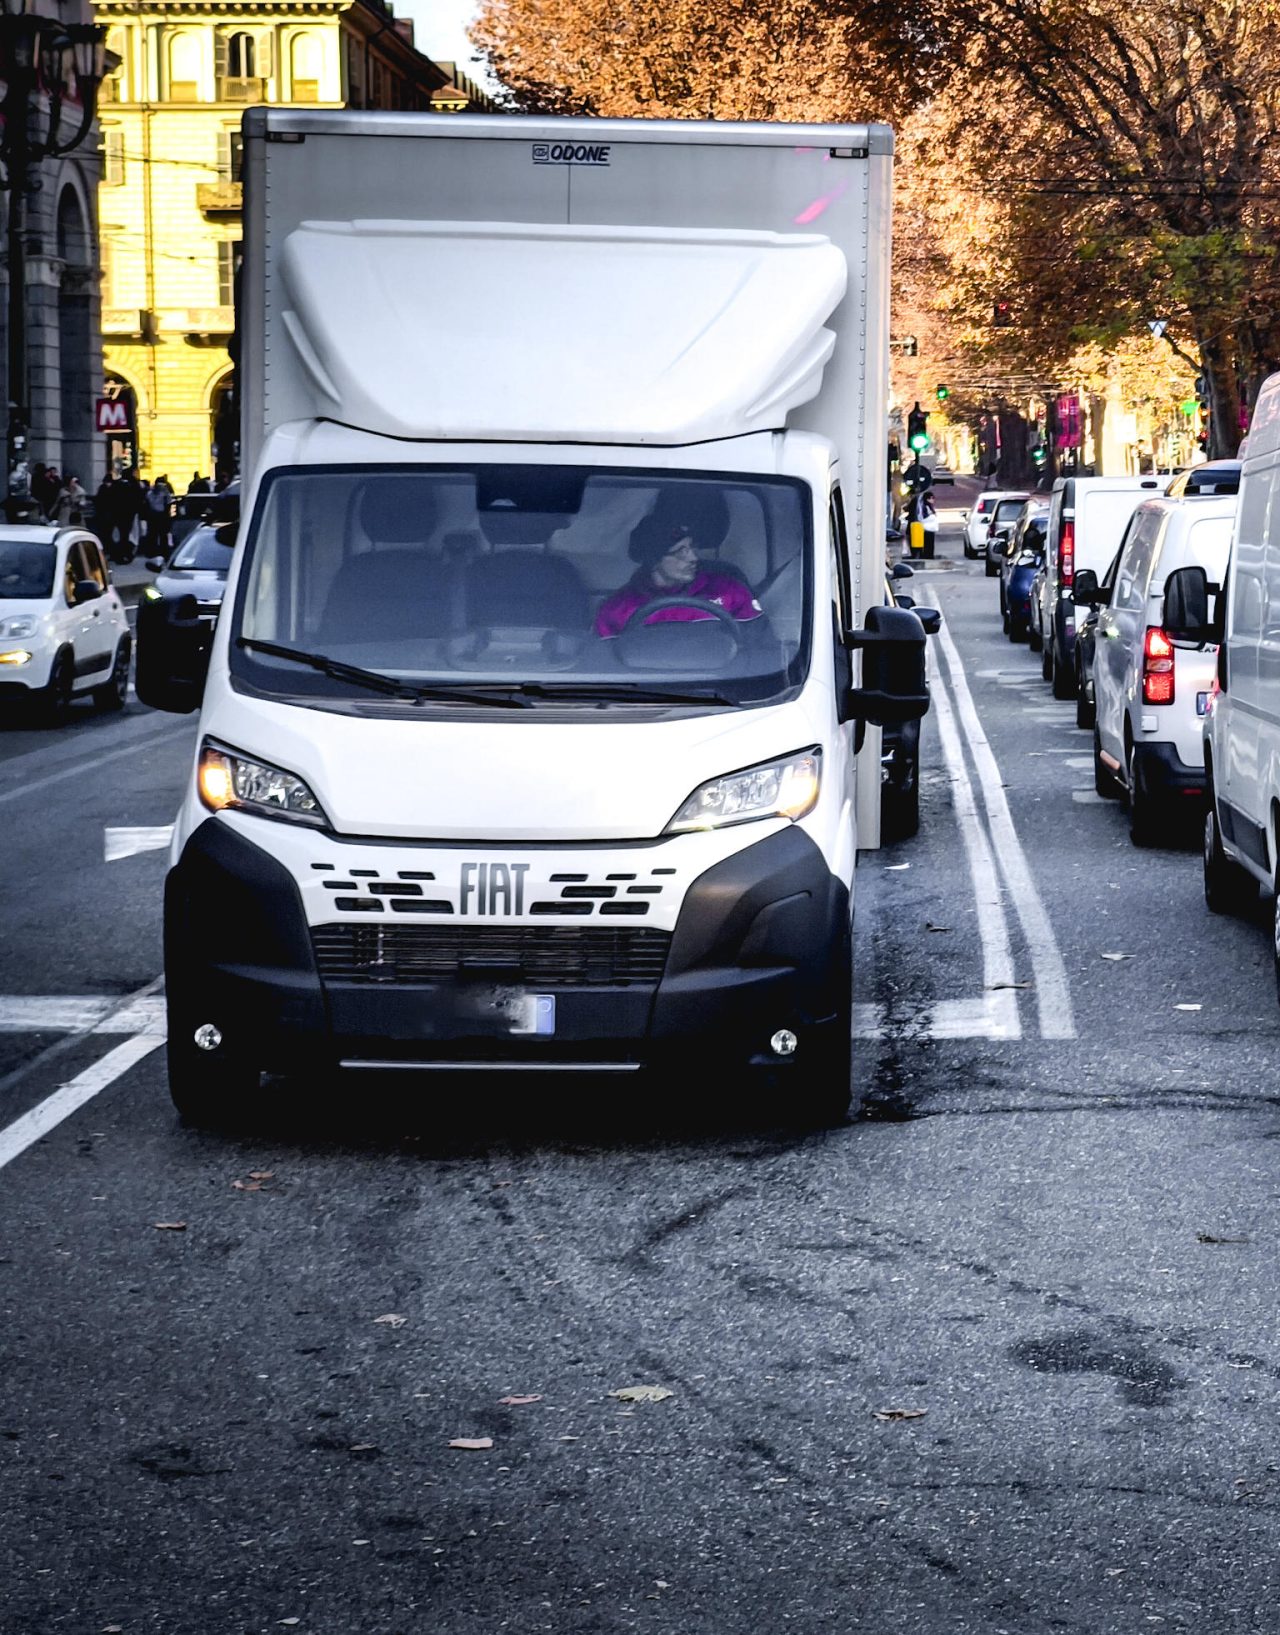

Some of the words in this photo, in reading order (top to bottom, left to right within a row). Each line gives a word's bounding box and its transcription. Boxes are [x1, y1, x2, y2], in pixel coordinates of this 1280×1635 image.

[551, 145, 611, 161] ODONE
[100, 403, 127, 426] M
[460, 863, 530, 915] FIAT
